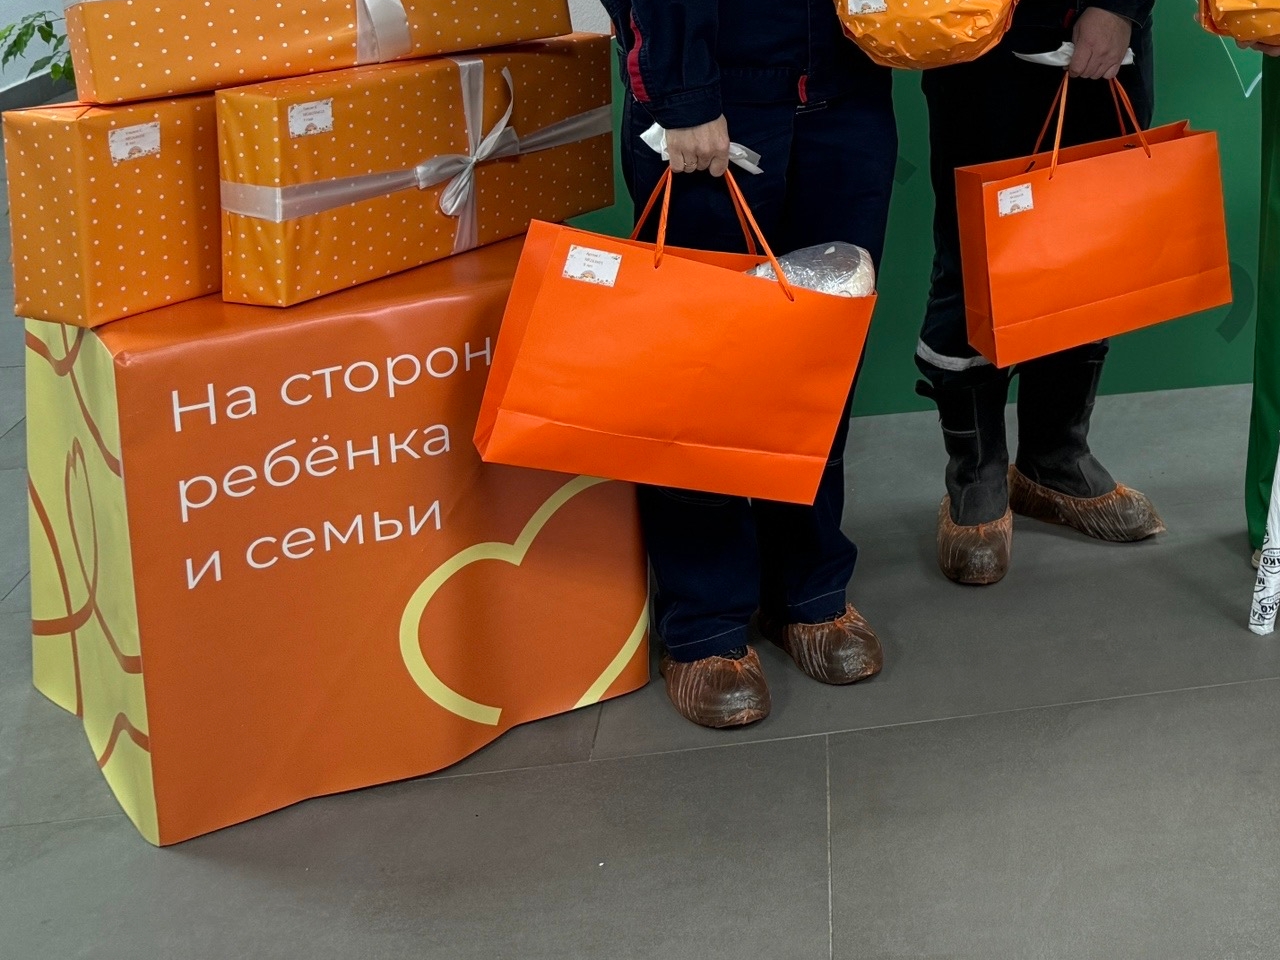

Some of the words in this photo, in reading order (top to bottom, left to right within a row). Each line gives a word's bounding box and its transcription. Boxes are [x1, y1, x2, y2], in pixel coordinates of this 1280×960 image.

[171, 383, 258, 433] На
[280, 336, 492, 407] сторон
[178, 424, 450, 524] ребёнка
[185, 550, 222, 590] и
[246, 500, 442, 570] семьи
